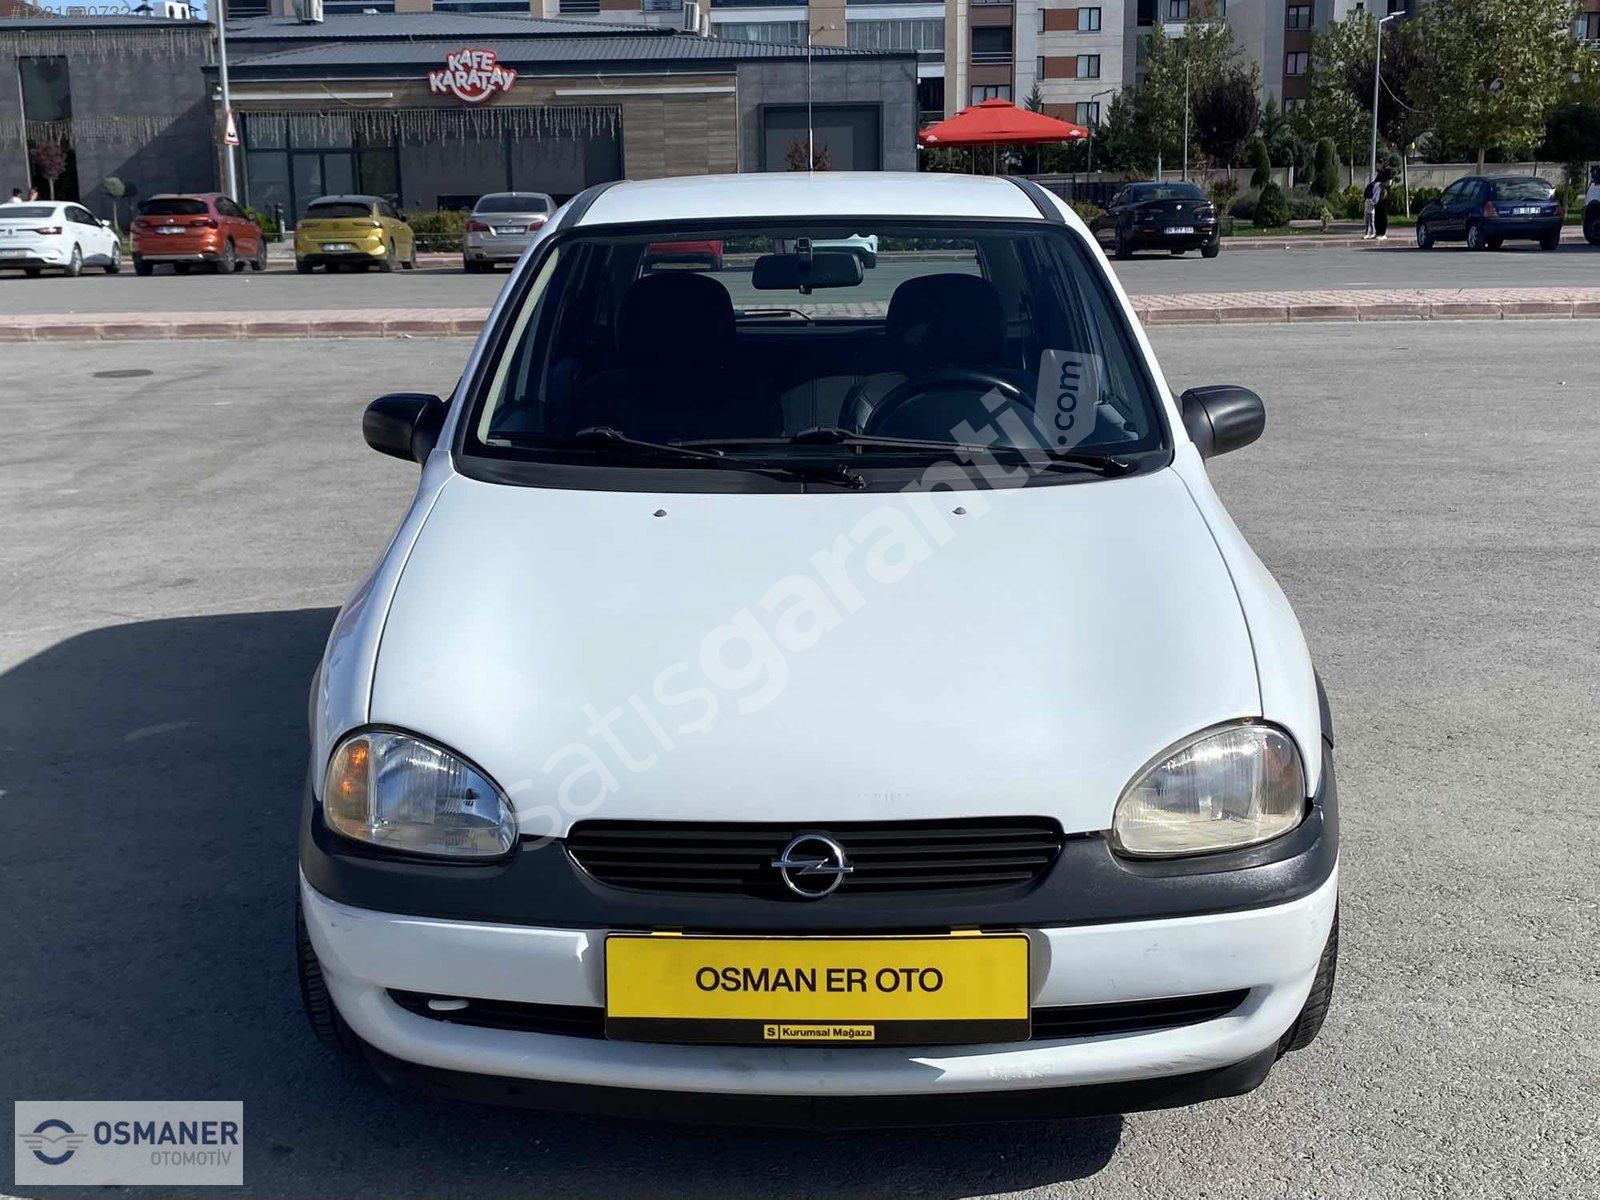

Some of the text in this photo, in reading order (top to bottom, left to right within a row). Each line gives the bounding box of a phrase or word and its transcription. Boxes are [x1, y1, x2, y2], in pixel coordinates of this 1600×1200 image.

[448, 48, 496, 72] KAFE
[429, 66, 515, 93] KARATAY
[695, 966, 944, 993] OSMAN ER OTO
[782, 1027, 830, 1037] Kurumsal
[833, 1027, 872, 1038] Mağaza
